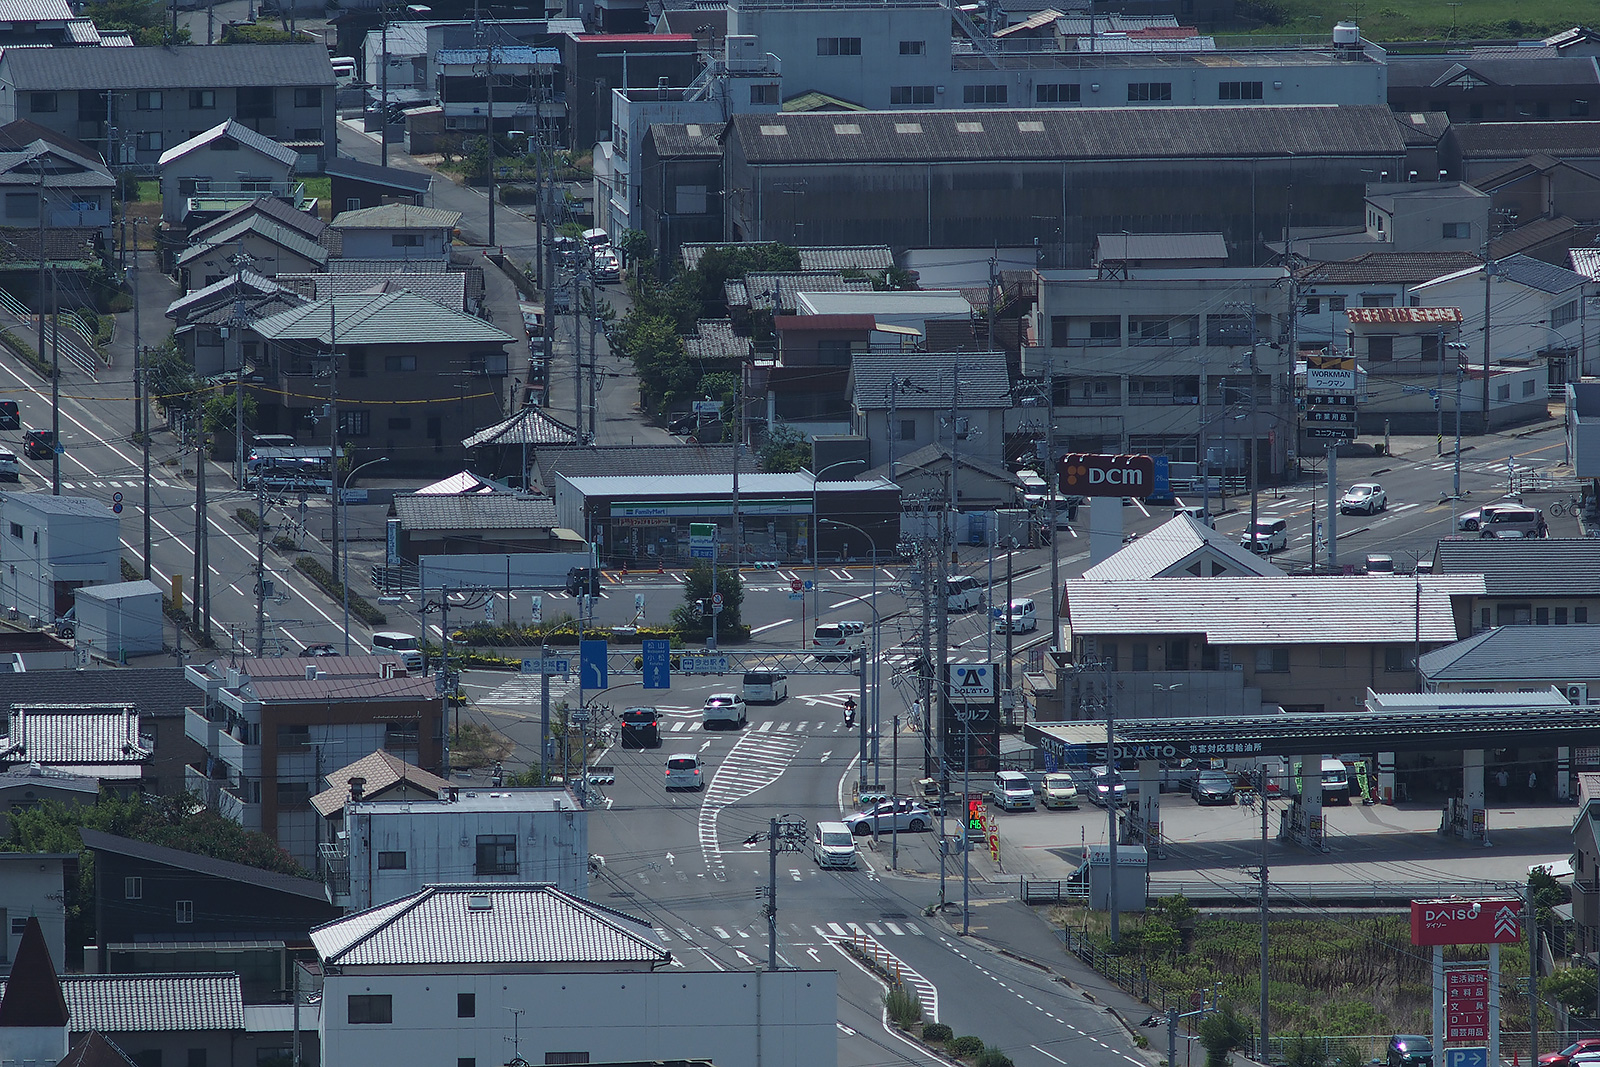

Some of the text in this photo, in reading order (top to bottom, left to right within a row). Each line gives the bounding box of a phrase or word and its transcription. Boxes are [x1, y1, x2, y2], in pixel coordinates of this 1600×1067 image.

[1315, 429, 1346, 437] ユニフォーム
[954, 710, 990, 721] セルフ
[1096, 745, 1176, 759] SOLATO
[1190, 742, 1262, 754] 災害対応型給油所
[1425, 909, 1478, 921] DAISO
[1451, 988, 1484, 998] 食料品
[1451, 1002, 1484, 1011] 文具
[1452, 1015, 1483, 1024] DIY
[1451, 1028, 1484, 1037] 園芸用品
[1454, 1052, 1466, 1067] P
